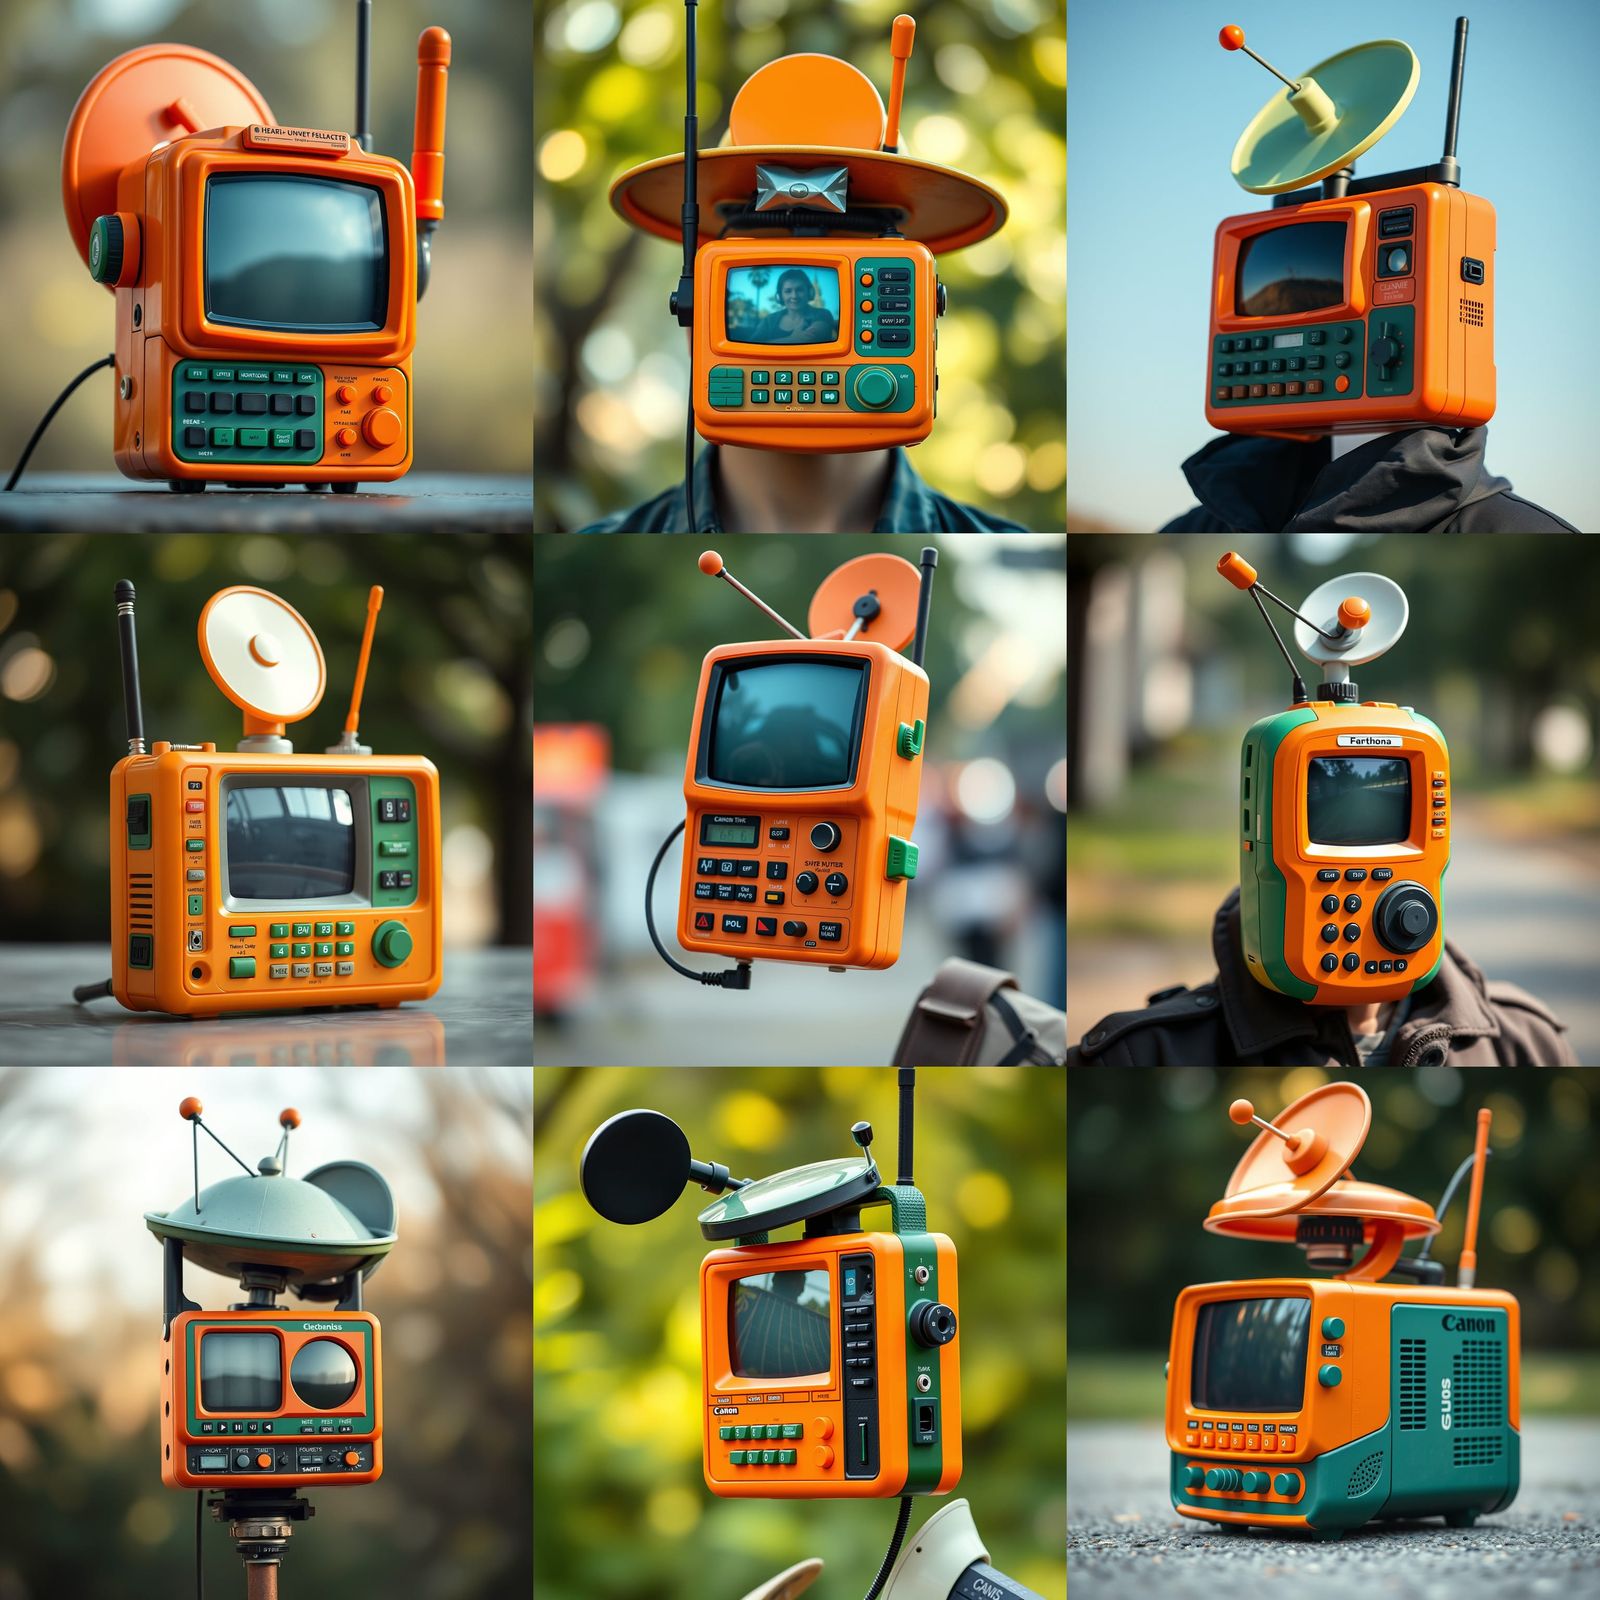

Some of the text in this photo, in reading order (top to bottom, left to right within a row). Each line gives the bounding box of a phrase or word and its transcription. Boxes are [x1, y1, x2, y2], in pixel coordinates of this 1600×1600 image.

[758, 374, 763, 382] 1
[780, 374, 787, 382] 2
[802, 374, 810, 382] B
[826, 374, 834, 382] P
[758, 393, 763, 401] 1
[1350, 900, 1357, 908] 2
[725, 920, 742, 928] POL
[344, 925, 350, 933] 2
[278, 947, 284, 955] 4
[300, 946, 307, 955] 5
[1441, 1314, 1496, 1333] Canon
[713, 1407, 738, 1415] Canon
[972, 1578, 1004, 1600] CANIS
